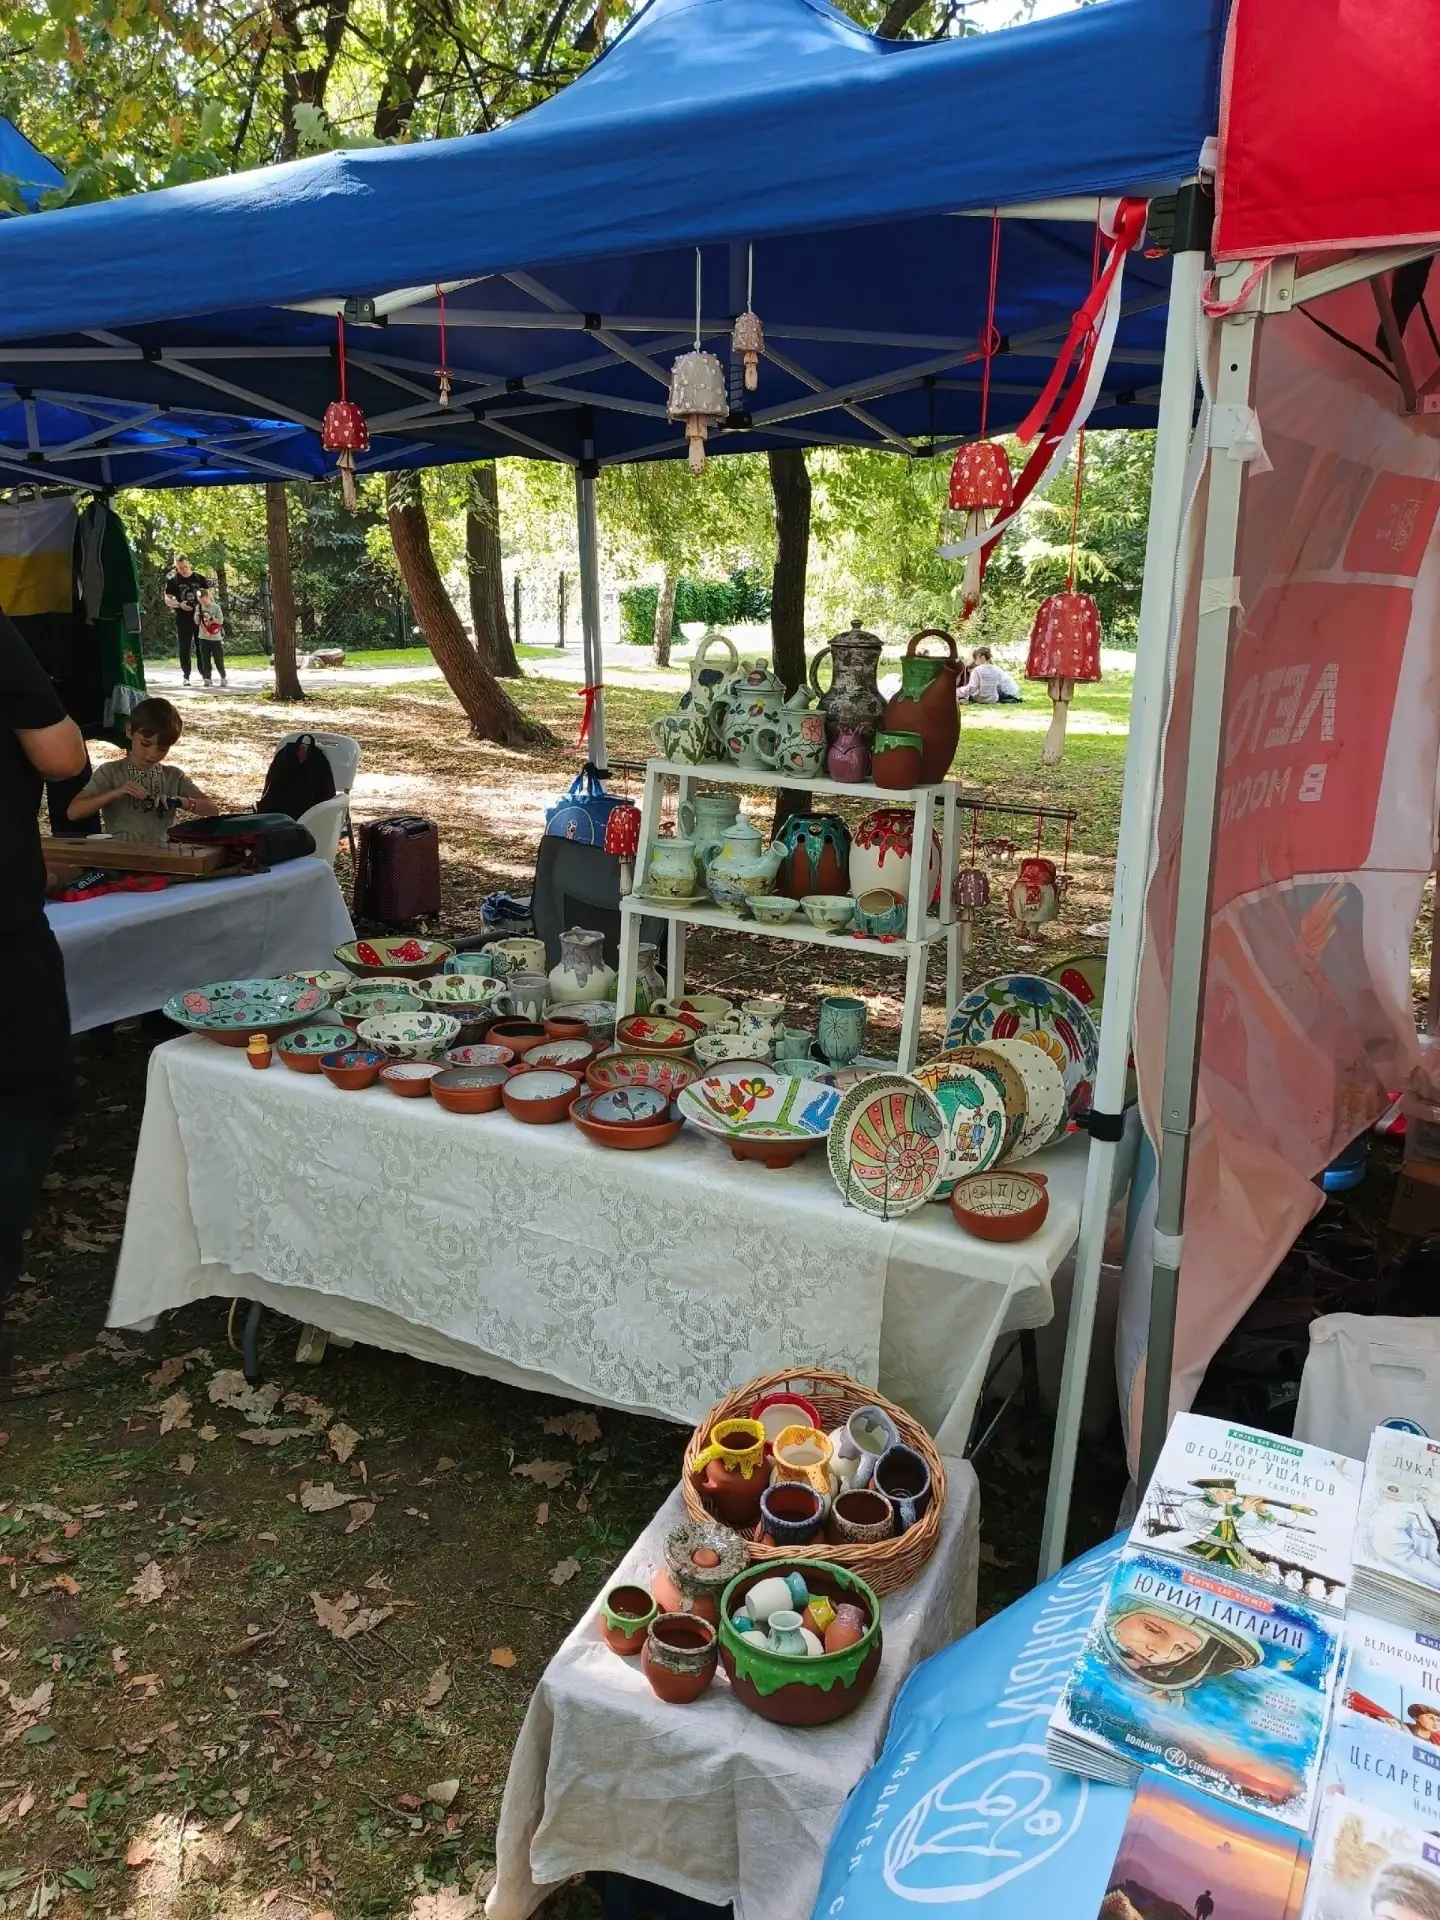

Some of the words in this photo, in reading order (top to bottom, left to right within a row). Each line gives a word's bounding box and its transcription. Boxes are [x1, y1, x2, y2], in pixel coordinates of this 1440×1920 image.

[1185, 1441, 1256, 1470] ФЕОДОР
[1265, 1461, 1336, 1497] УШАКОВ
[1393, 1456, 1433, 1479] ЛУКА
[1187, 1575, 1215, 1591] ЖИЗНЬ
[1217, 1584, 1232, 1598] КАК
[1134, 1573, 1202, 1612] ЮРИЙ
[1211, 1599, 1304, 1649] ГАГАРИН
[1420, 1635, 1440, 1649] ЖИЗ
[1125, 1733, 1162, 1755] ВОЛЬНЫЙ
